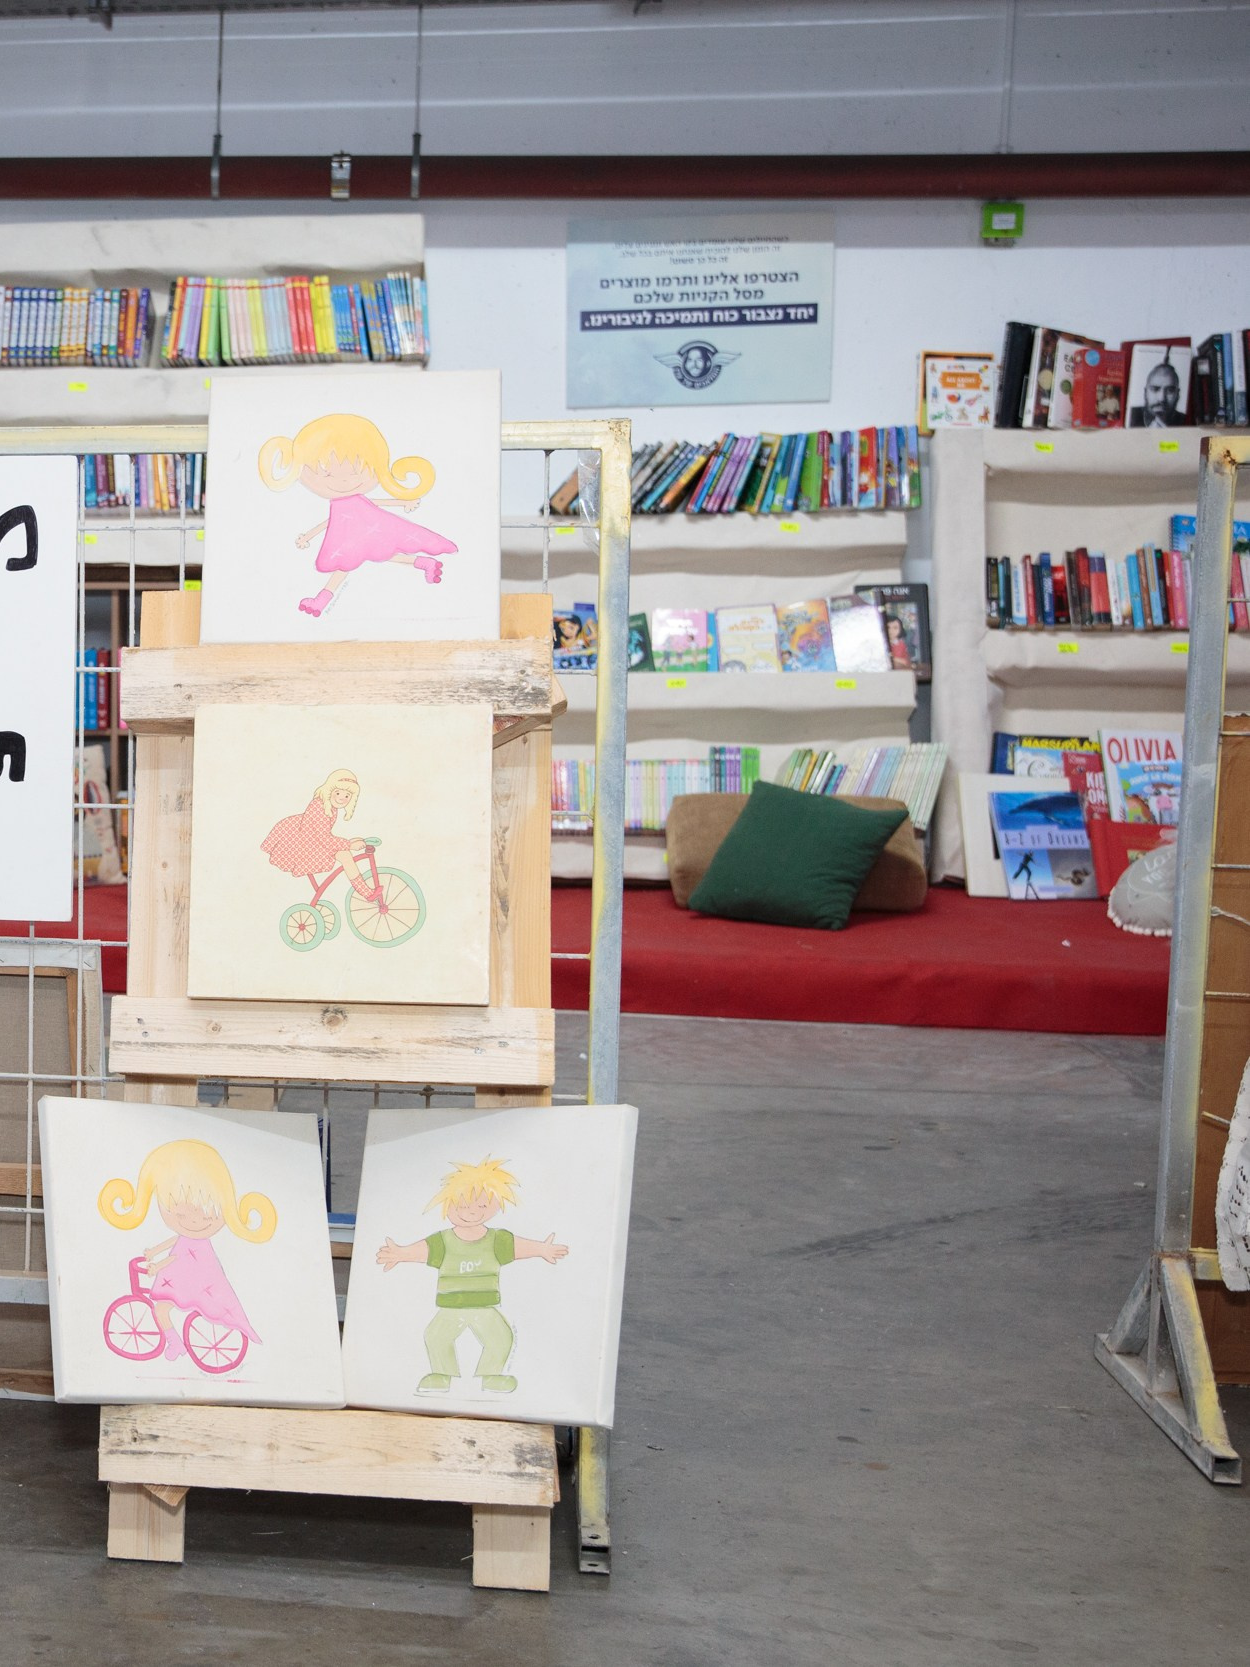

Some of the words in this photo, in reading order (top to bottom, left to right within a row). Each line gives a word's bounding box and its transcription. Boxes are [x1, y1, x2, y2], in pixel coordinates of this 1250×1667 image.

[600, 277, 651, 290] מוצרים
[656, 275, 699, 288] ותרמו
[703, 272, 739, 285] אלינו
[744, 272, 799, 285] הצטרפו
[633, 291, 674, 304] שלכם
[679, 290, 729, 303] הקניות
[733, 288, 764, 300] מסל
[584, 310, 652, 327] לגיבורינו.
[654, 310, 710, 325] ותמיכה
[713, 309, 740, 323] כוח
[742, 307, 784, 321] נצבור
[786, 306, 815, 321] יחד
[1107, 735, 1177, 765] OLIVIA
